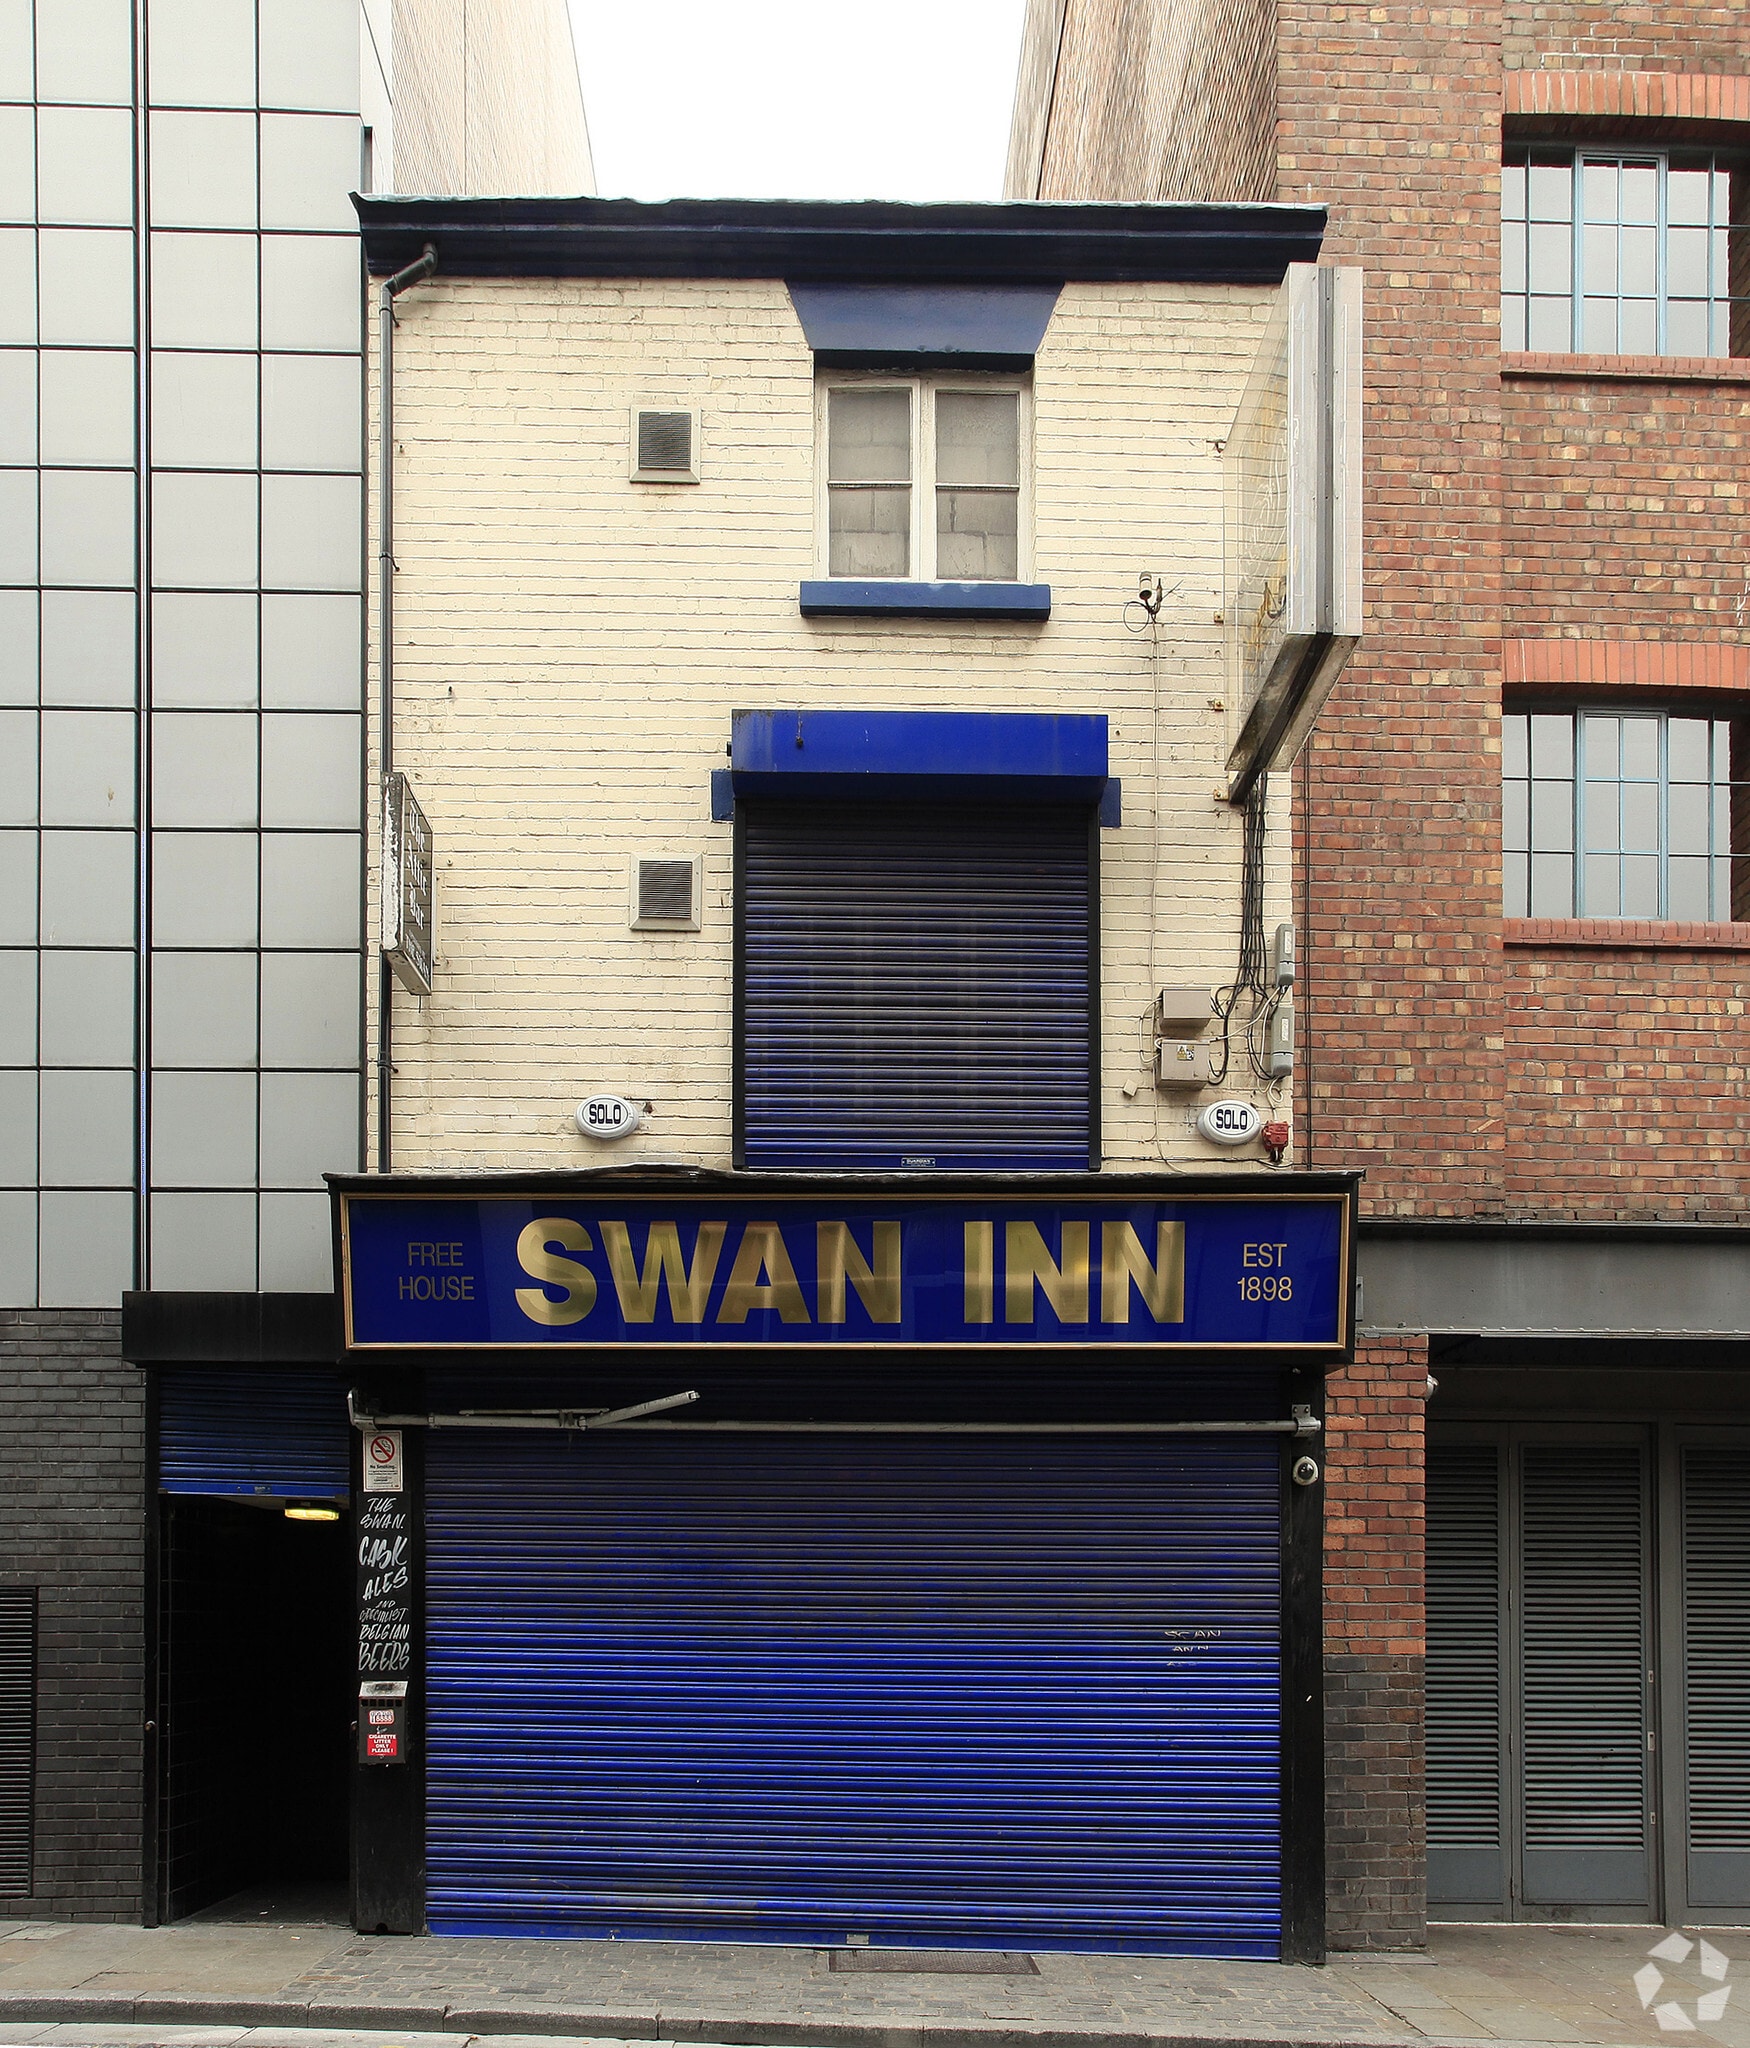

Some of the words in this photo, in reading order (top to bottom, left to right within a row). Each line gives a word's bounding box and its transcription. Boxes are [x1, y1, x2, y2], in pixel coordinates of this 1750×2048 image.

[589, 1104, 622, 1124] SOLO
[1215, 1109, 1248, 1130] SOLO
[407, 1242, 464, 1266] FREE
[1243, 1243, 1288, 1267] EST
[514, 1217, 902, 1326] SWAN
[964, 1221, 1185, 1323] INN
[398, 1276, 475, 1300] HOUSE
[1237, 1276, 1293, 1301] 1898
[367, 1497, 397, 1512] THE
[358, 1535, 408, 1569] CASK
[362, 1566, 409, 1601] ALES
[359, 1623, 410, 1640] BELGIAN
[358, 1640, 410, 1671] BEERS
